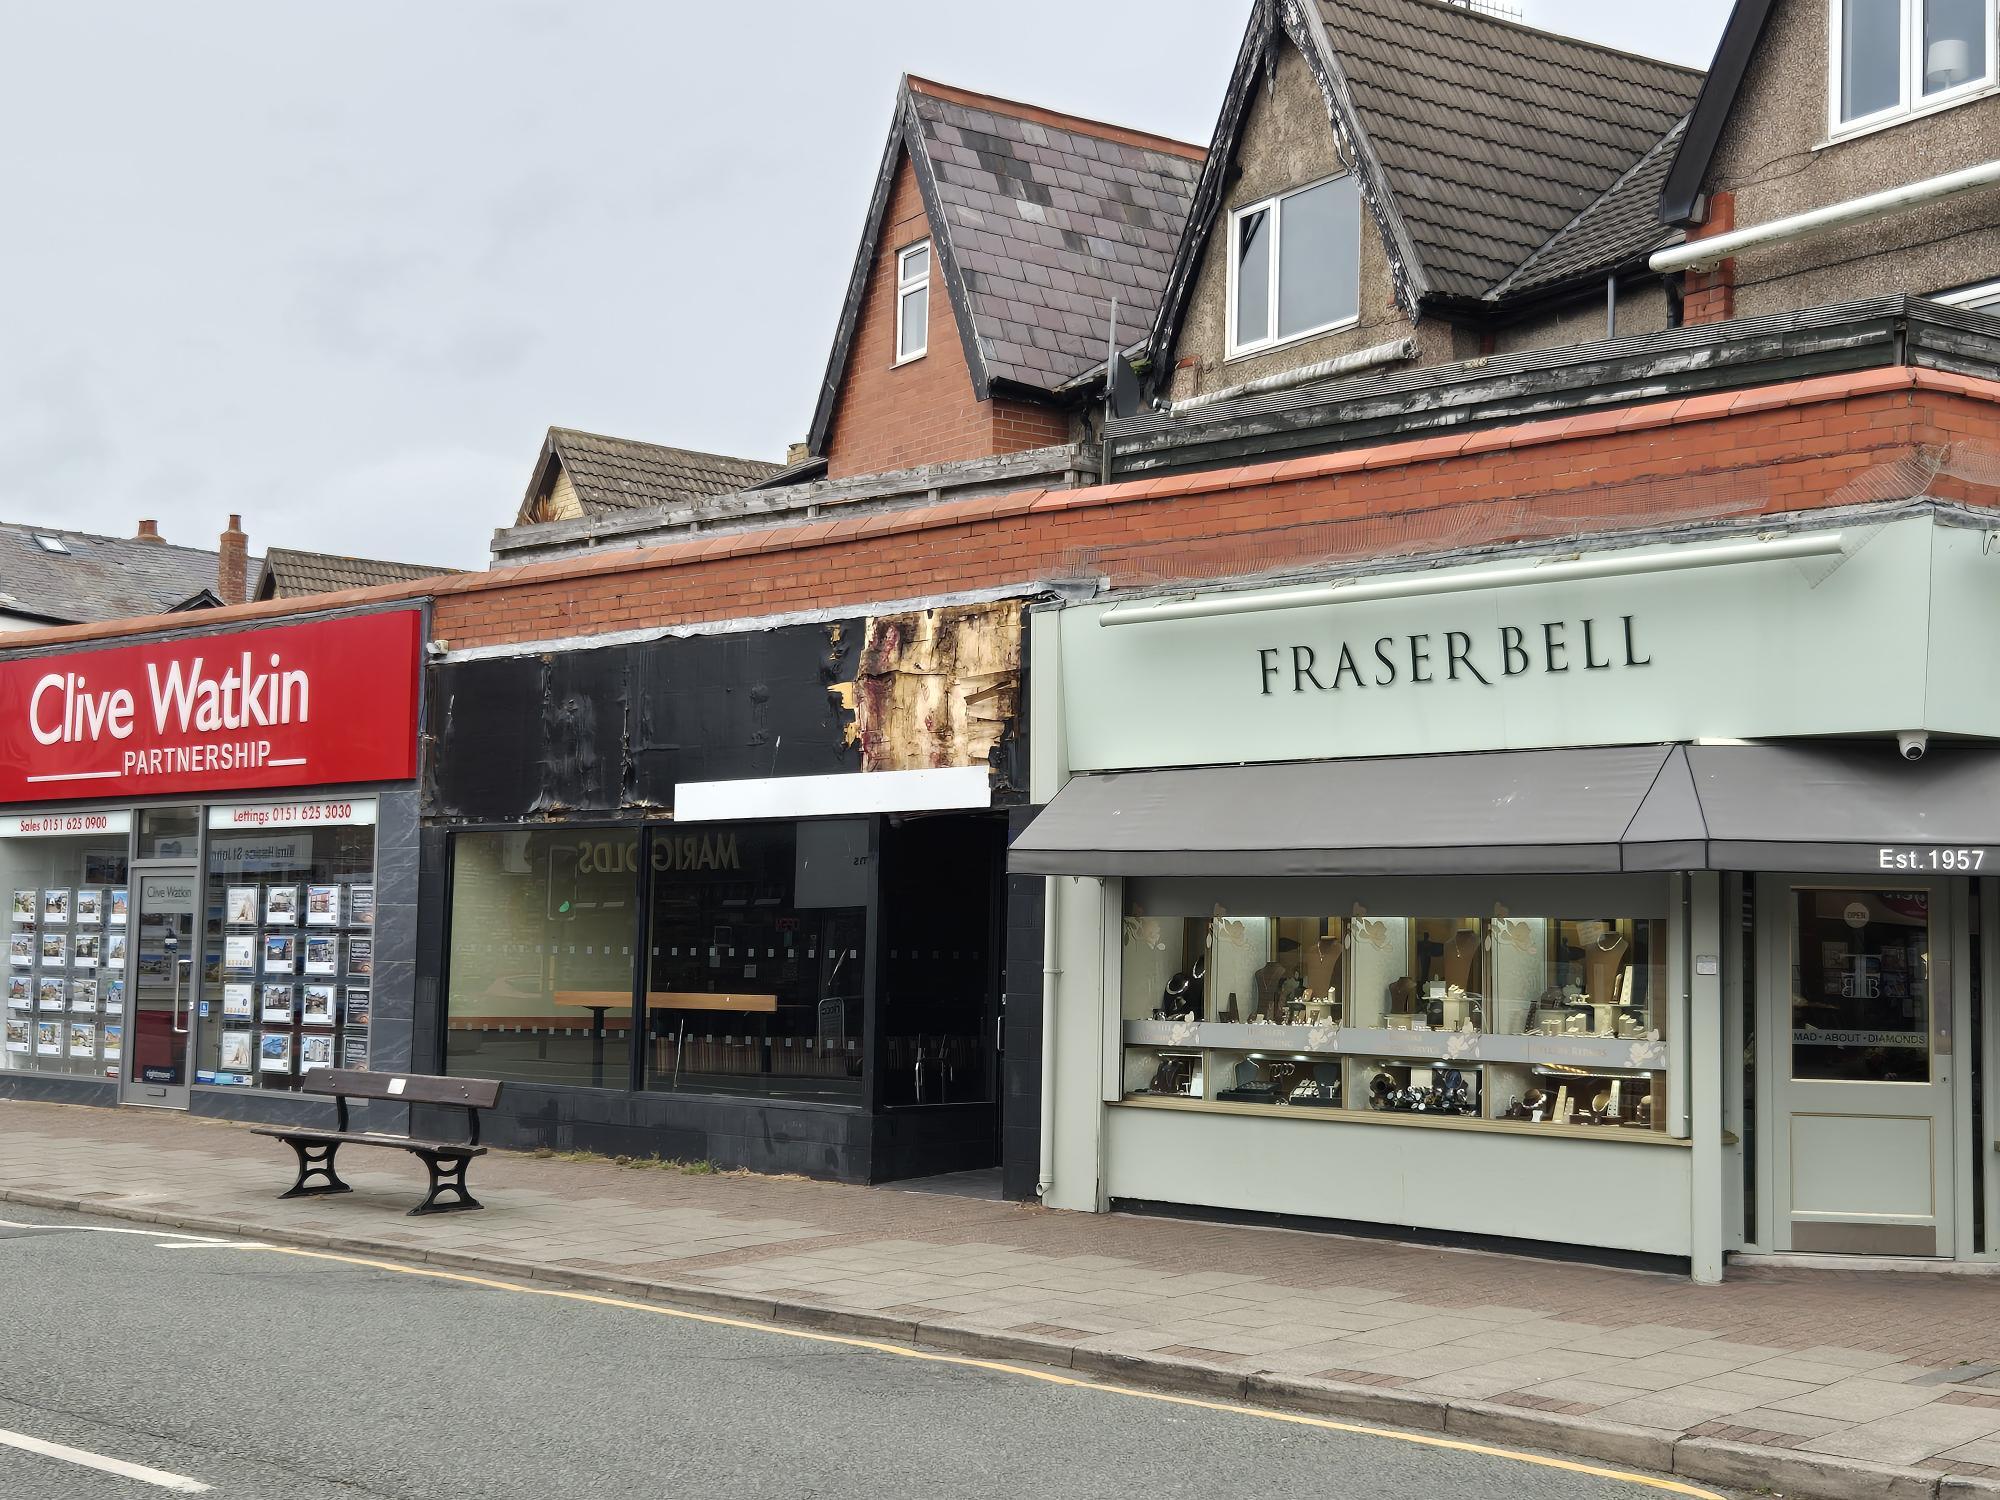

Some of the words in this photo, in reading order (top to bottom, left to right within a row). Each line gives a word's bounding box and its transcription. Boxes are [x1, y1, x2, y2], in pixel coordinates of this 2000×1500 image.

[29, 672, 135, 746] Clive
[148, 651, 309, 736] Watkin
[124, 740, 271, 776] PARTNERSHIP
[20, 819, 40, 832] Sales
[43, 818, 63, 831] 0151
[66, 817, 82, 829] 625
[85, 816, 107, 829] 0900
[234, 808, 270, 825] Lettings
[272, 807, 297, 822] 0151
[302, 805, 321, 819] 625
[325, 804, 352, 819] 3030
[1794, 1032, 1817, 1042] MAD
[1824, 1032, 1860, 1043] ABOUT
[1868, 1033, 1925, 1045] DIAMONDS
